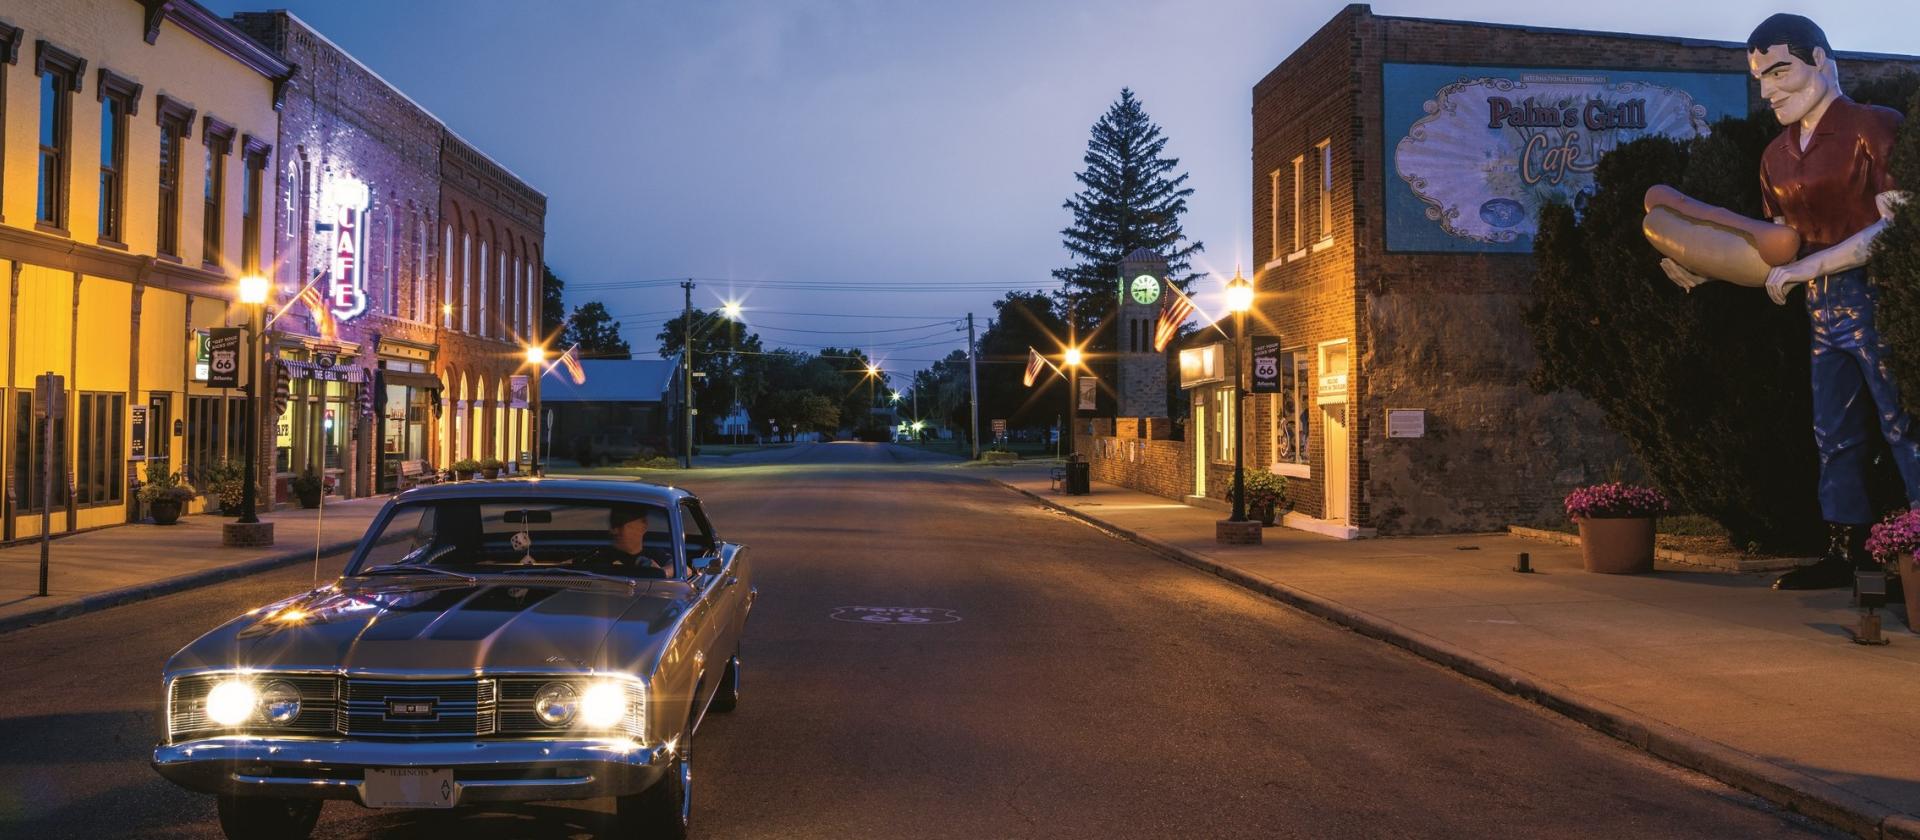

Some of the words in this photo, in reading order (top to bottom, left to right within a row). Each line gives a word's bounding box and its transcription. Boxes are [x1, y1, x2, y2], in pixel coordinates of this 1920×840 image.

[1487, 97, 1578, 128] Palm's
[1584, 99, 1648, 130] Grill
[1521, 132, 1599, 185] Cafe
[336, 204, 354, 306] CAFE
[216, 360, 232, 369] 66
[314, 369, 324, 380] THE
[325, 371, 337, 381] GRILL
[1259, 366, 1274, 375] 66
[861, 614, 931, 622] 66
[390, 768, 429, 777] ILLINOIS
